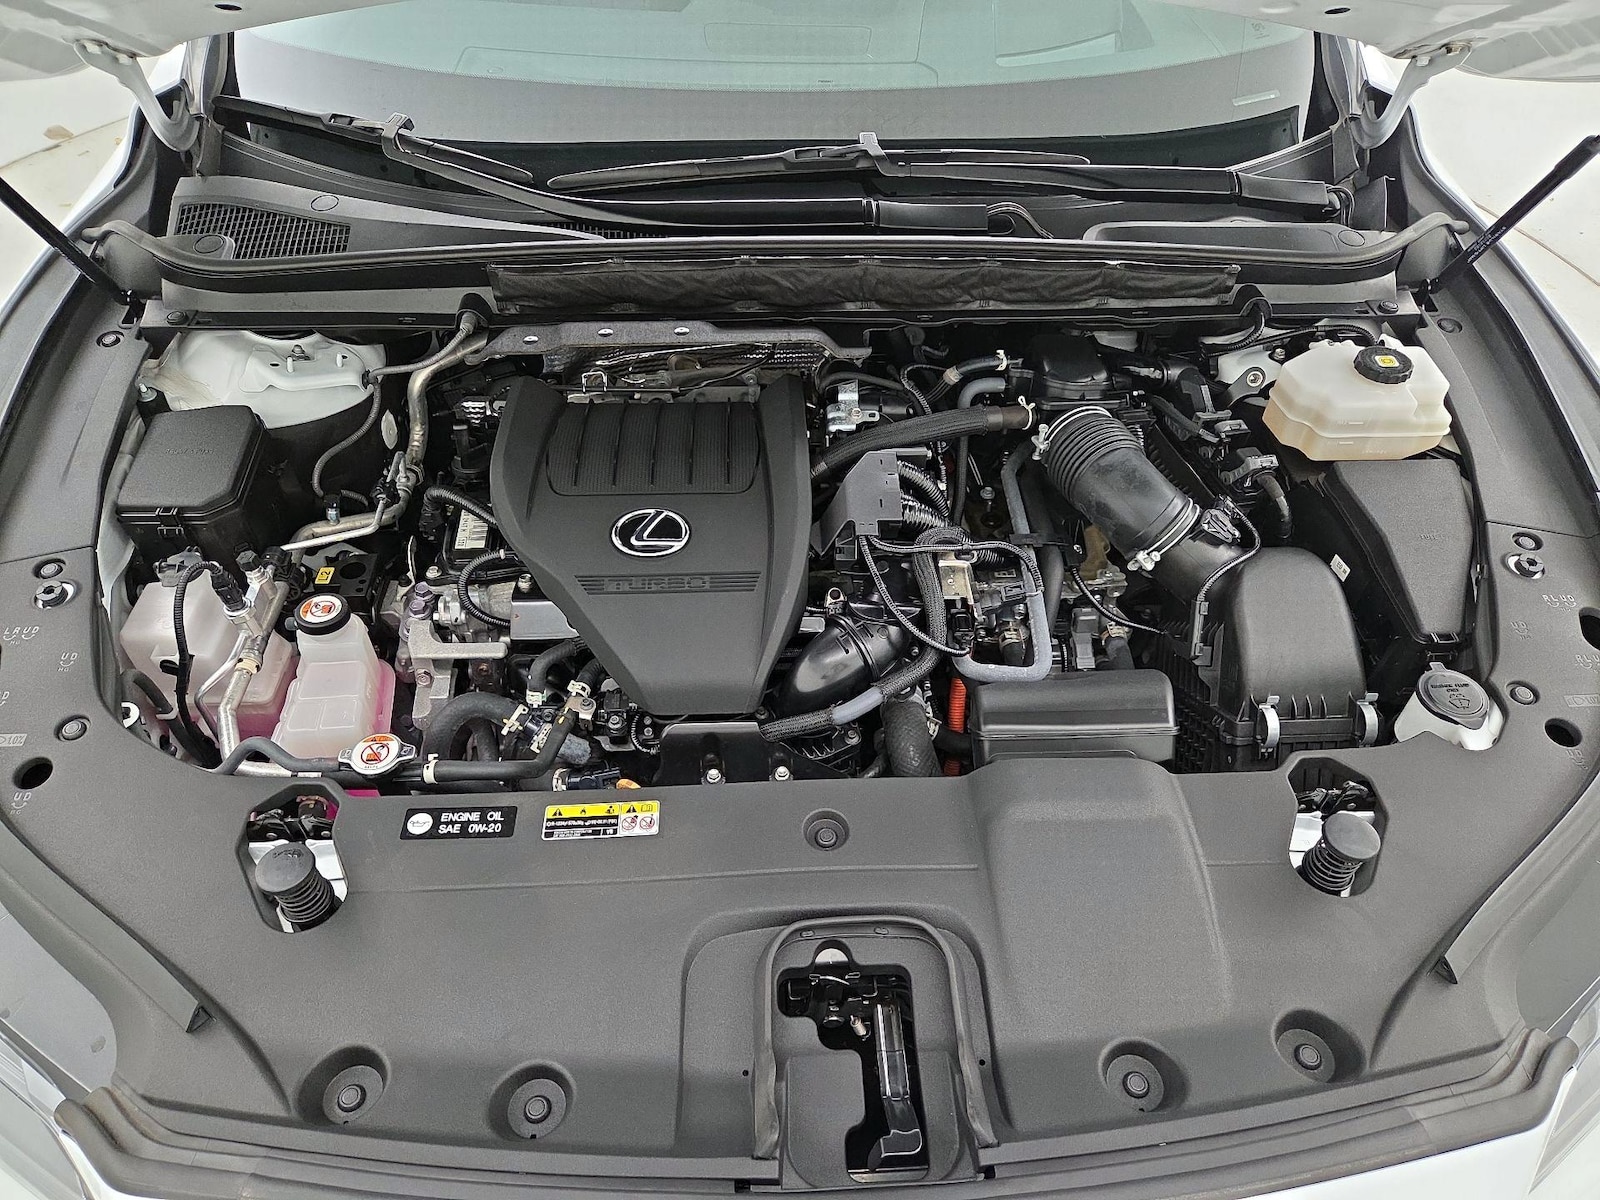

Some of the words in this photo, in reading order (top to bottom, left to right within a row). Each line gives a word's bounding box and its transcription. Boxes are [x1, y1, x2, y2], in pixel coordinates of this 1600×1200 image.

[606, 577, 708, 590] TURBO
[440, 811, 481, 822] ENGINE
[486, 811, 505, 821] OIL
[438, 823, 461, 834] SAE
[468, 823, 502, 834] 0W-20
